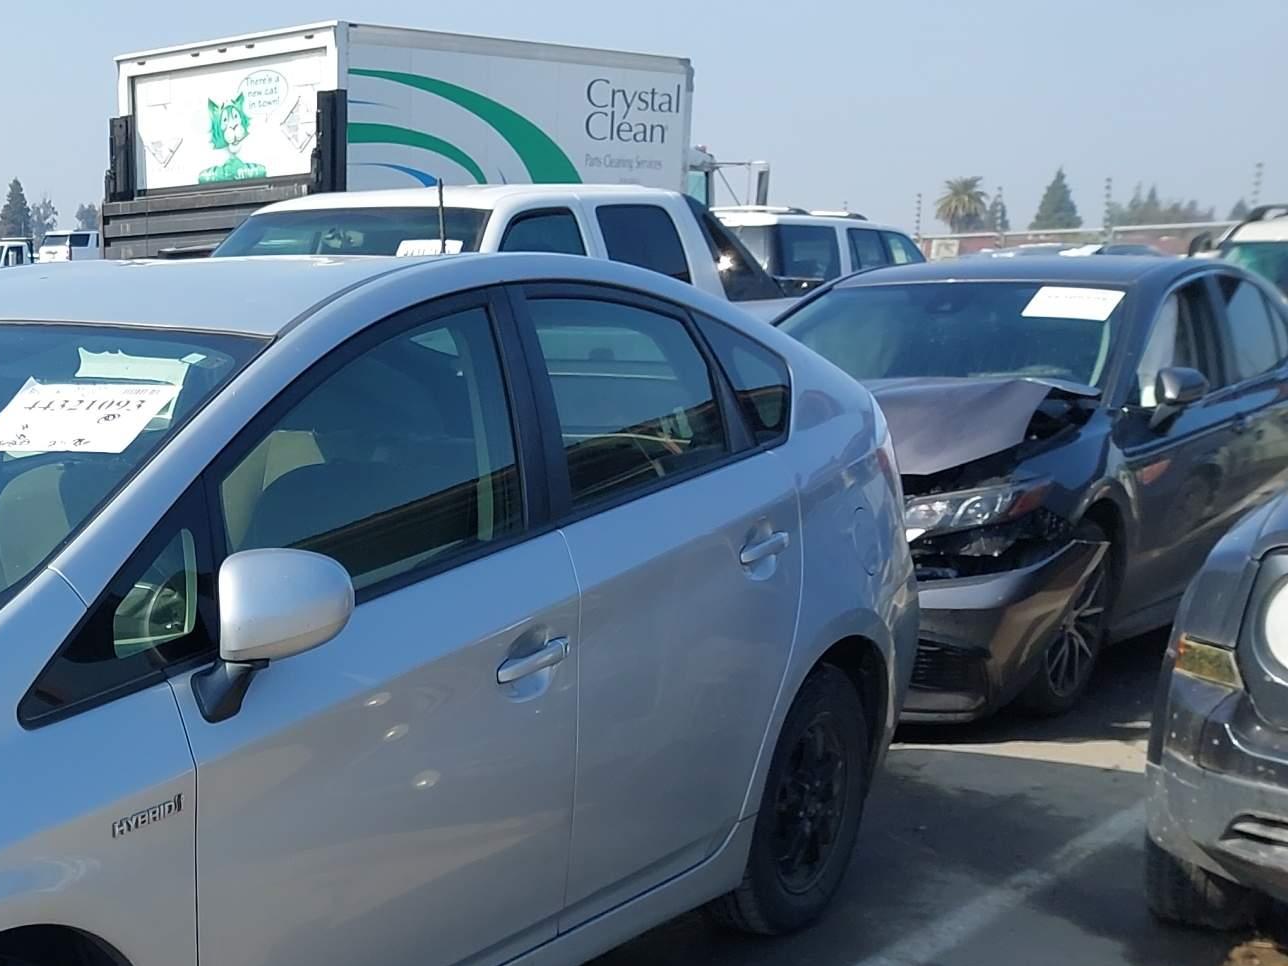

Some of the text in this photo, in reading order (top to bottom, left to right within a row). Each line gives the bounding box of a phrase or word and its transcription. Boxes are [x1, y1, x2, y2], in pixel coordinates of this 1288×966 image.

[587, 79, 680, 120] Crystal
[585, 111, 665, 144] Clean
[24, 399, 146, 412] 44321093
[112, 800, 176, 838] HYBRID
